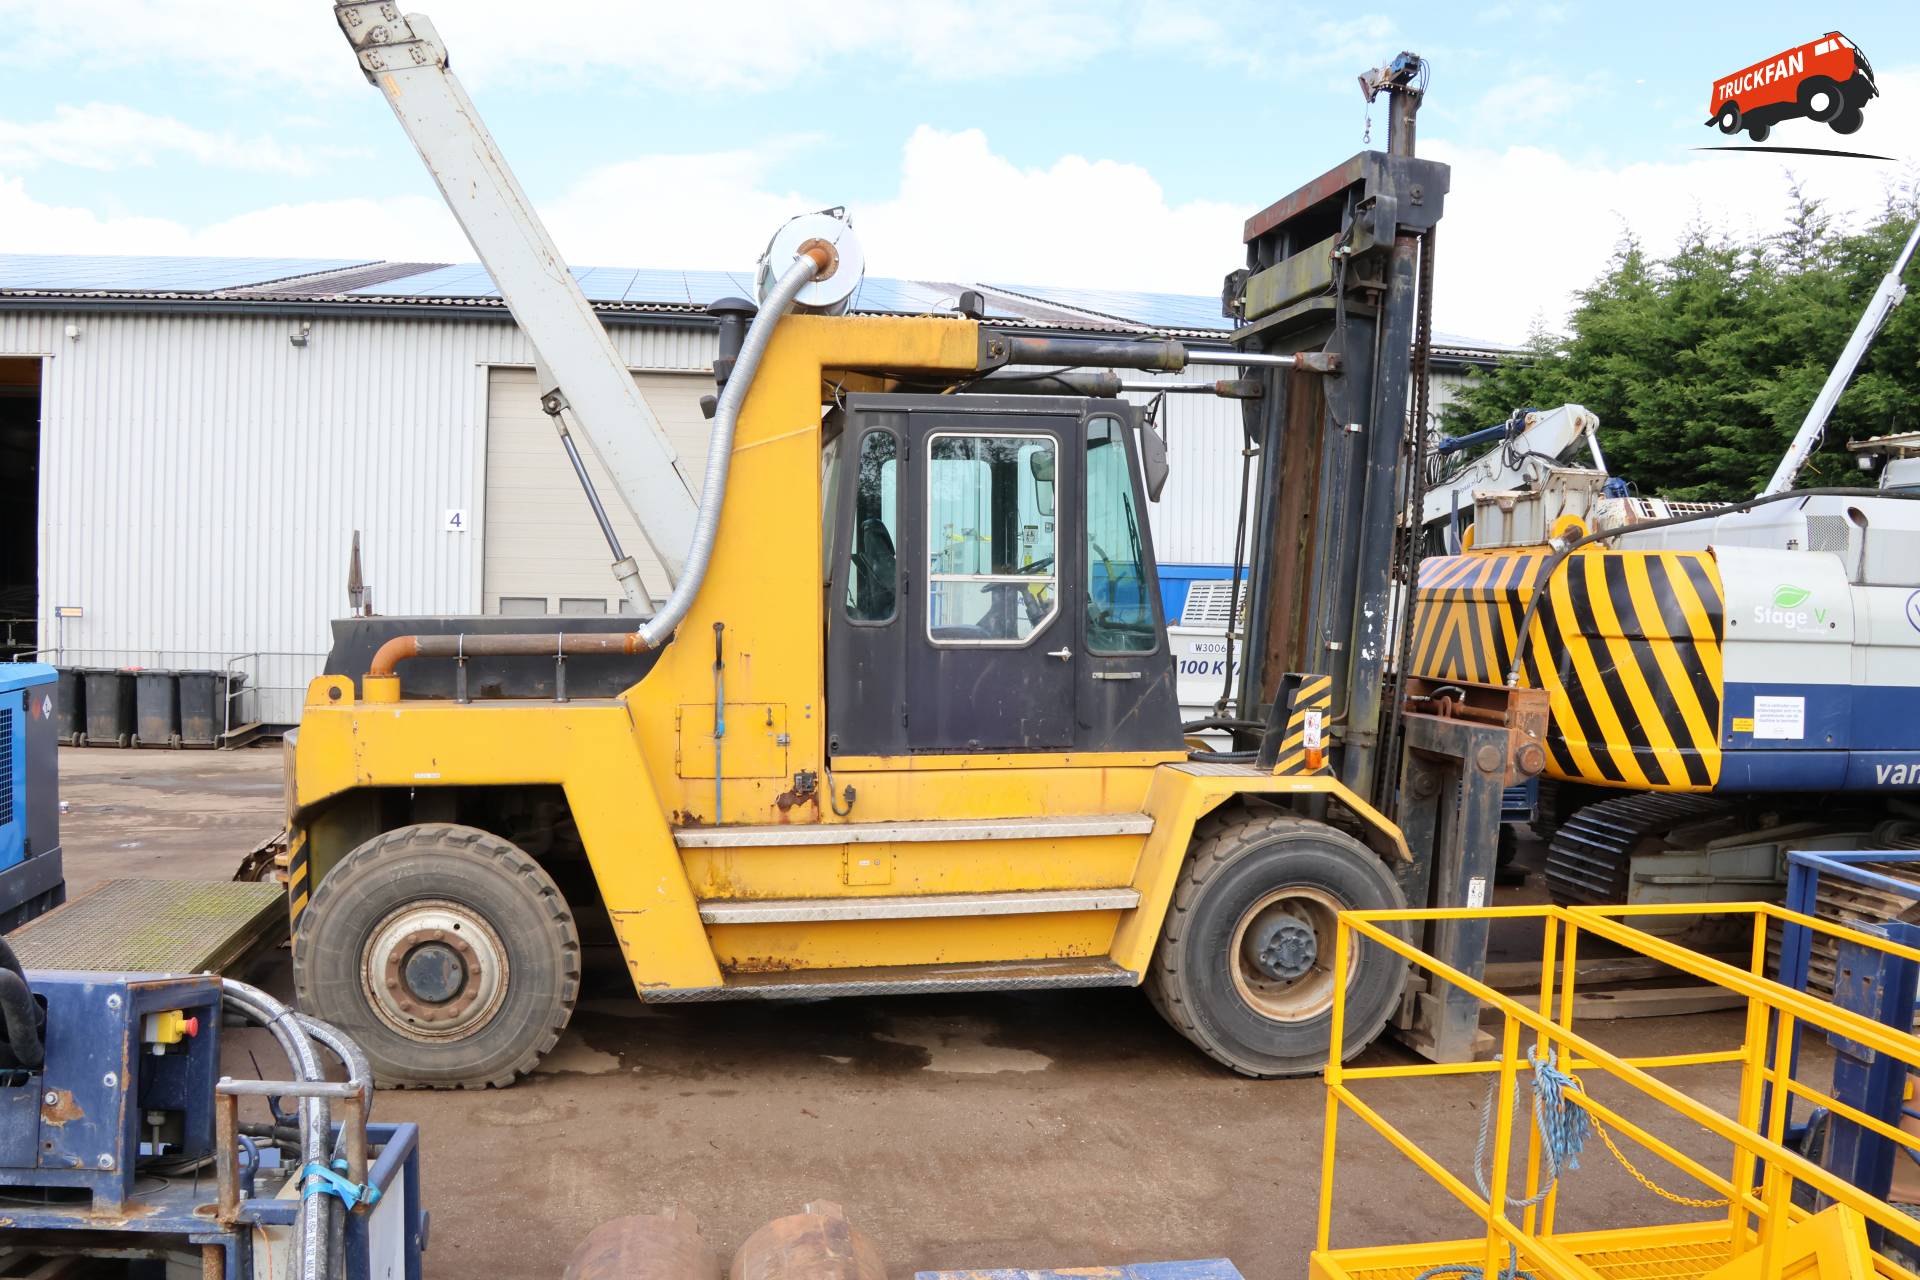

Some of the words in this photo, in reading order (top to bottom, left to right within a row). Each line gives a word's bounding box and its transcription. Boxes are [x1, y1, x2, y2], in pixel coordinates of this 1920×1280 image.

[449, 512, 462, 528] 4
[1753, 605, 1808, 629] Stage
[1814, 607, 1827, 625] V
[1179, 660, 1209, 675] 100
[1875, 763, 1920, 785] van
